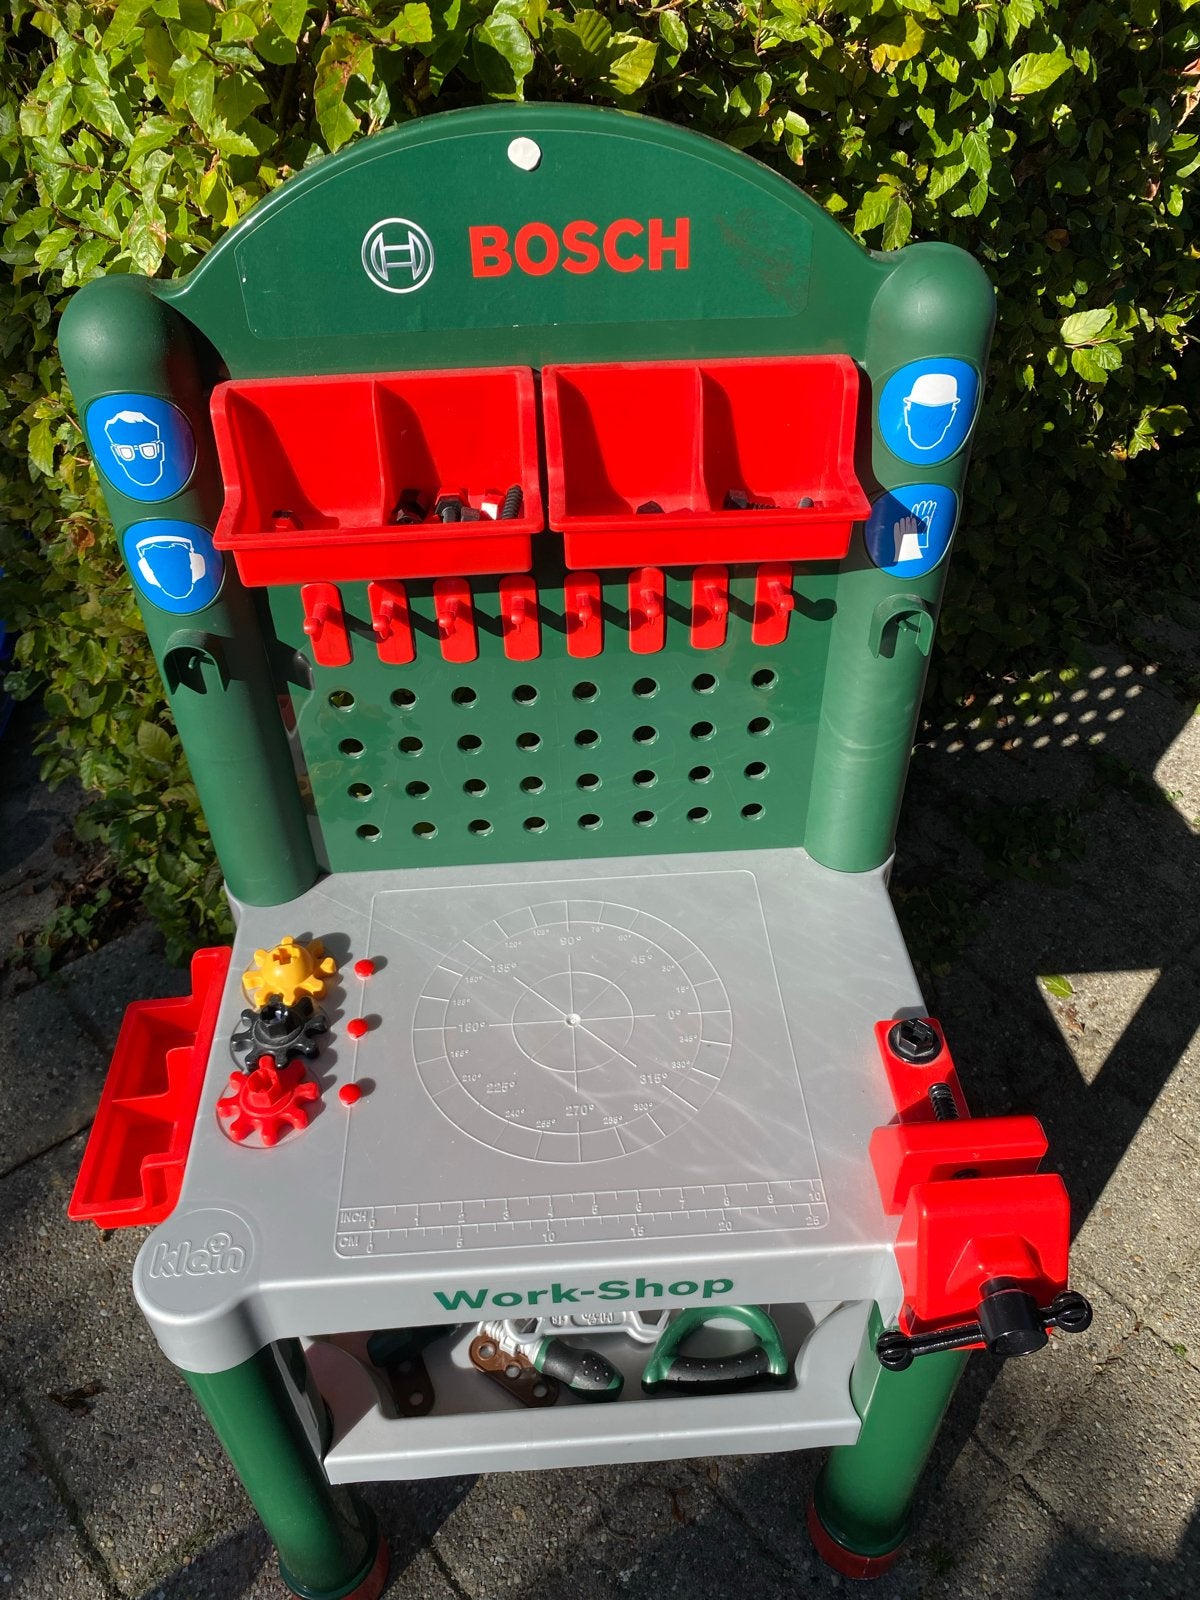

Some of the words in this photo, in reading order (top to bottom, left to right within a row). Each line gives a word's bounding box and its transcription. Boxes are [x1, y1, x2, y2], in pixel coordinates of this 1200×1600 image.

[469, 217, 690, 278] BOSCH
[667, 1009, 681, 1020] 0°
[640, 1072, 668, 1084] 315°
[565, 1104, 595, 1117] 270°
[339, 1211, 368, 1224] INCH
[338, 1236, 360, 1249] CM
[542, 1231, 556, 1243] 10
[149, 1232, 246, 1279] klein
[433, 1277, 735, 1311] Work-Shop
